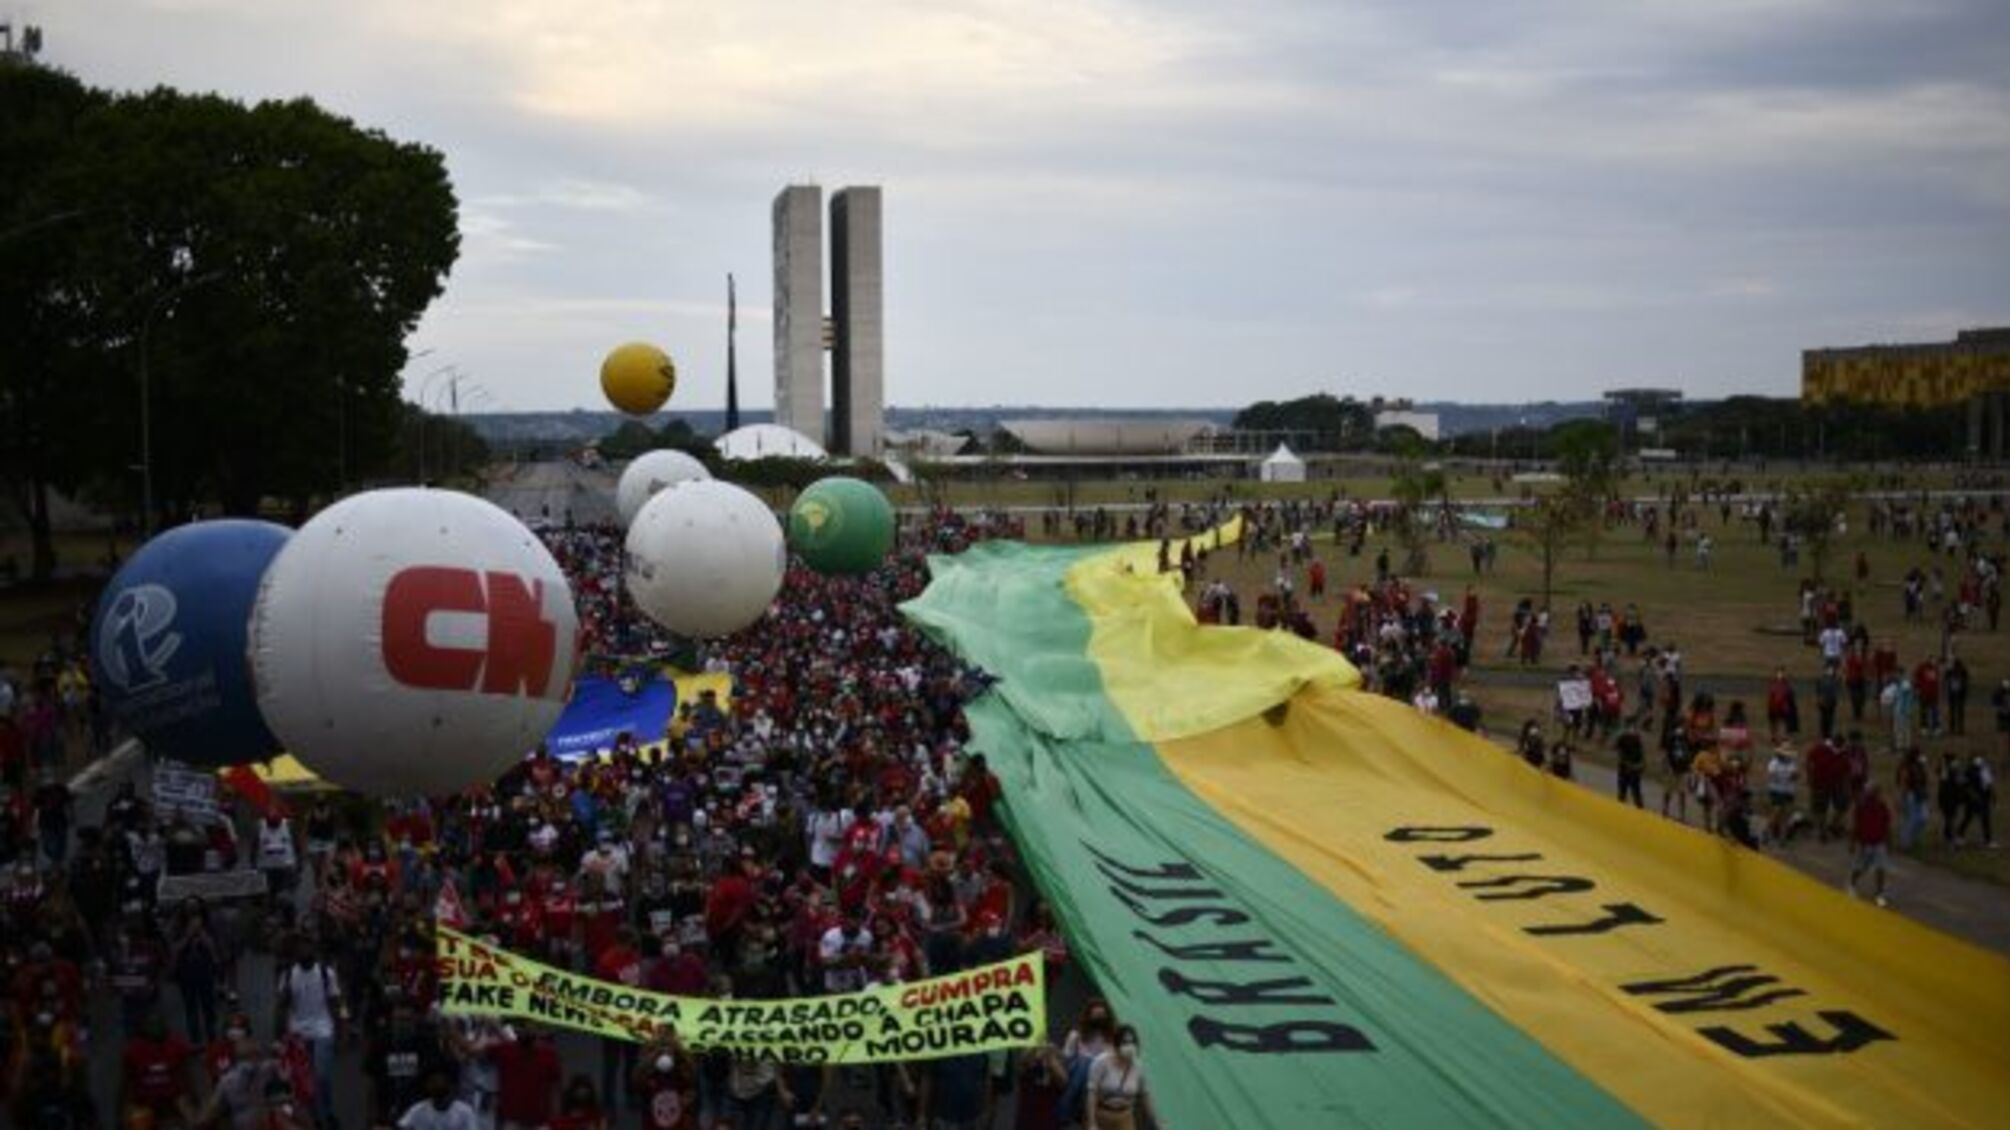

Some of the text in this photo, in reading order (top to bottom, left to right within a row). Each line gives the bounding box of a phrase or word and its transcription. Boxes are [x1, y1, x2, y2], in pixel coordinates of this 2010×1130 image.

[1079, 837, 1379, 1053] BRASIL
[1383, 827, 1899, 1059] EM LUTO
[436, 956, 498, 981] SUA
[880, 1014, 901, 1035] A
[914, 990, 1030, 1027] CHAPA
[438, 981, 514, 1008] FAKE
[538, 961, 1035, 1026] EMBORA ATRASADO, CUMPRA
